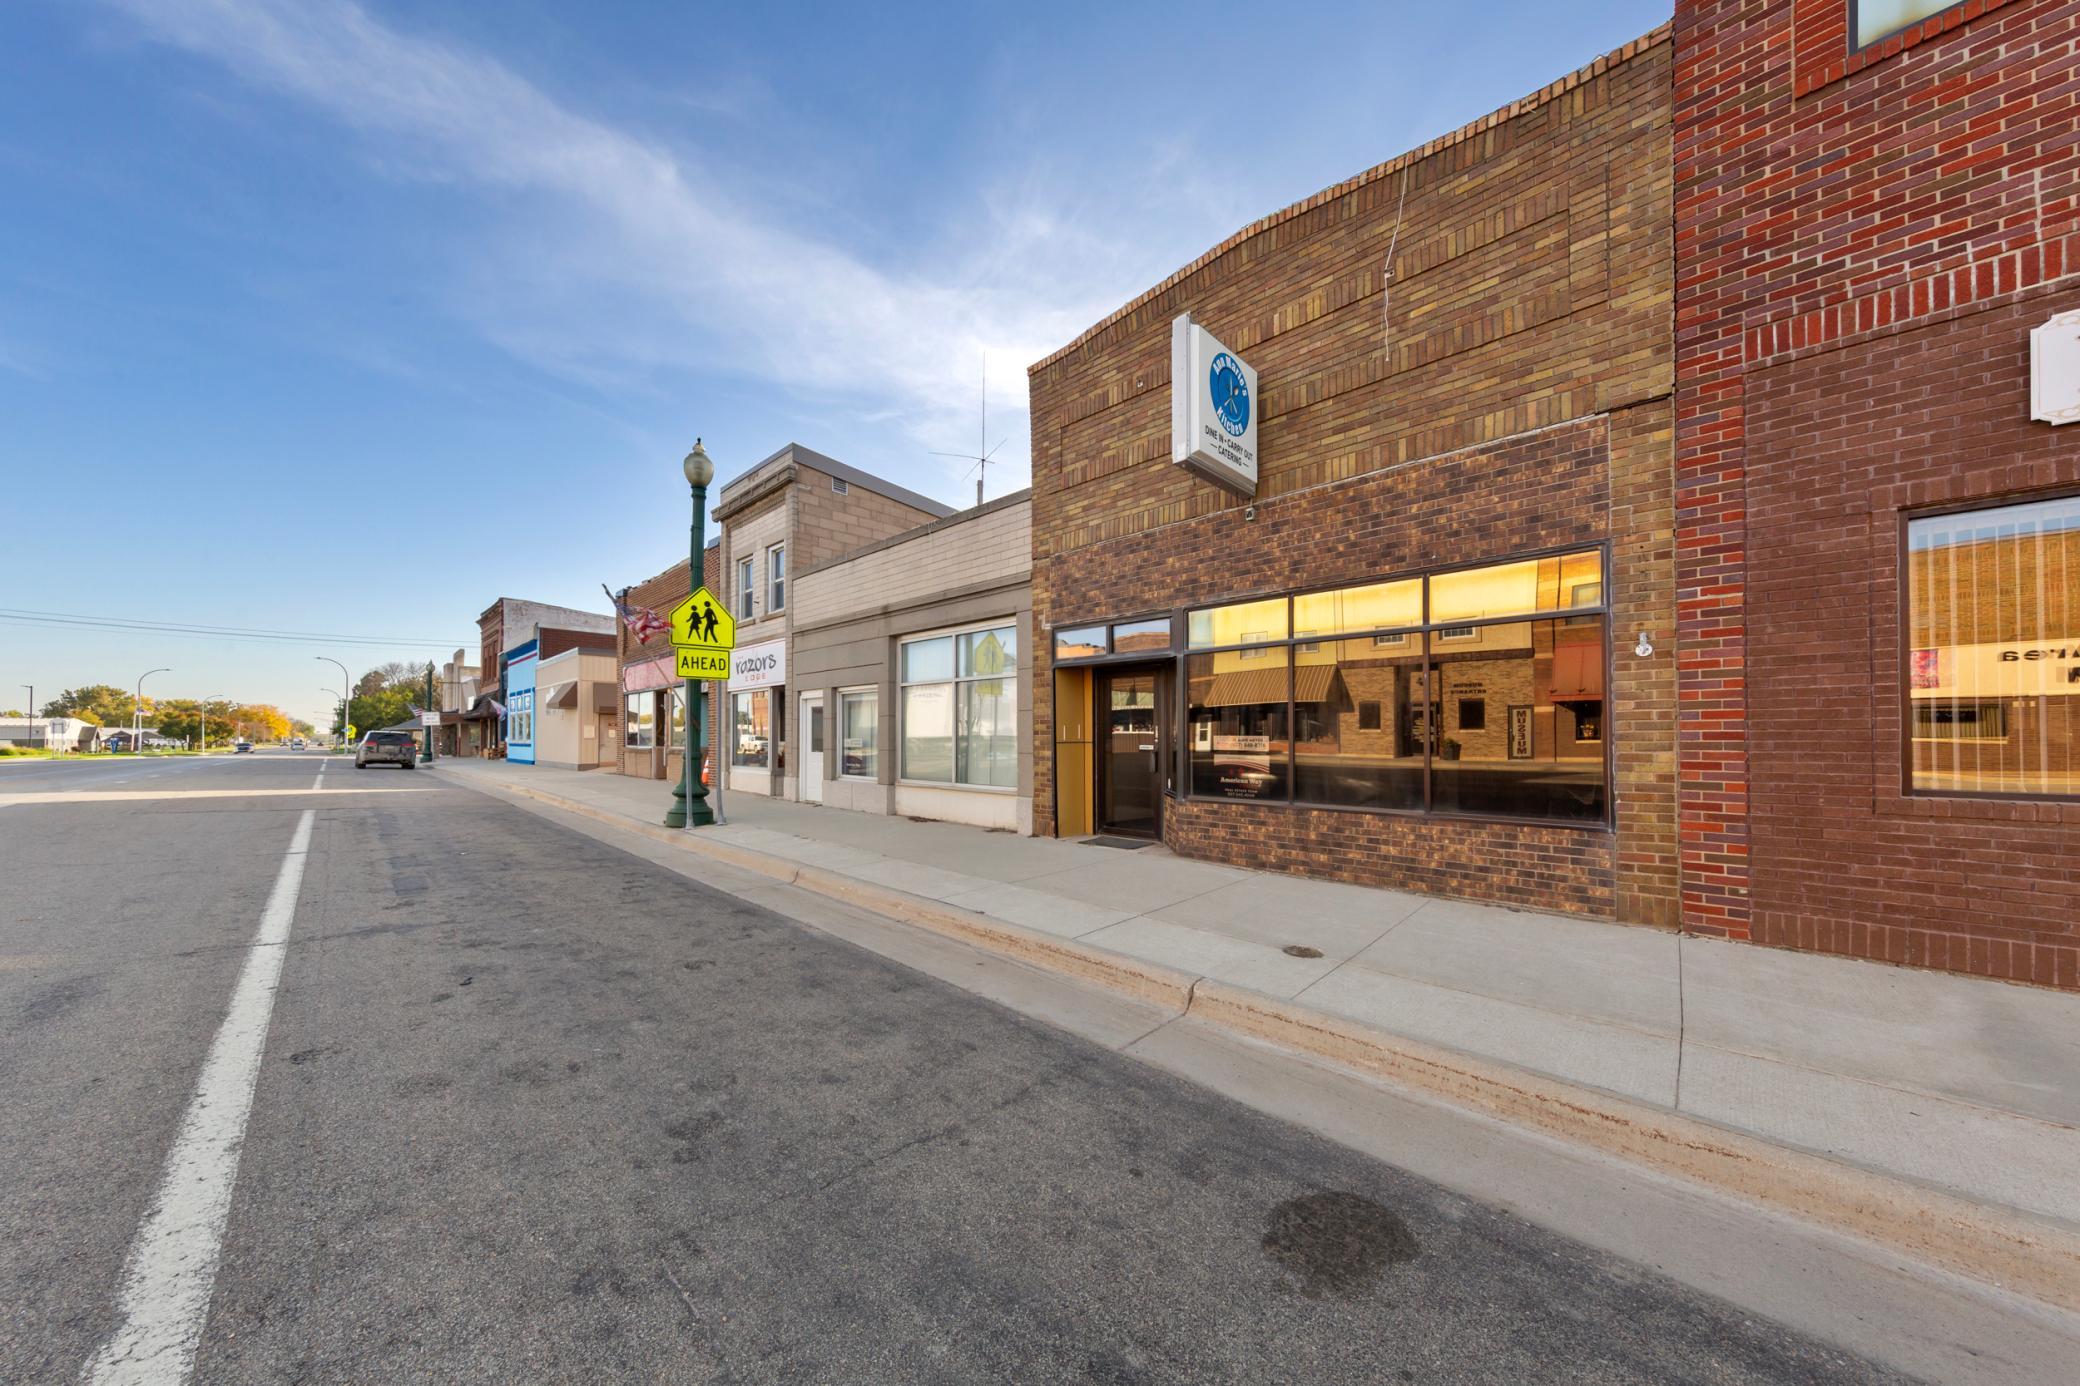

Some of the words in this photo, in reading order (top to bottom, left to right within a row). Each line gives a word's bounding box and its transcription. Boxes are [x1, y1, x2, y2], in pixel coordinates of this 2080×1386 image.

[1216, 405, 1244, 436] Kitchen
[1205, 424, 1218, 440] DINE
[1218, 433, 1225, 444] IN
[1227, 438, 1244, 455] CARRY
[1244, 449, 1254, 462] OUT
[1218, 445, 1243, 467] CATERING
[681, 655, 727, 671] AHEAD
